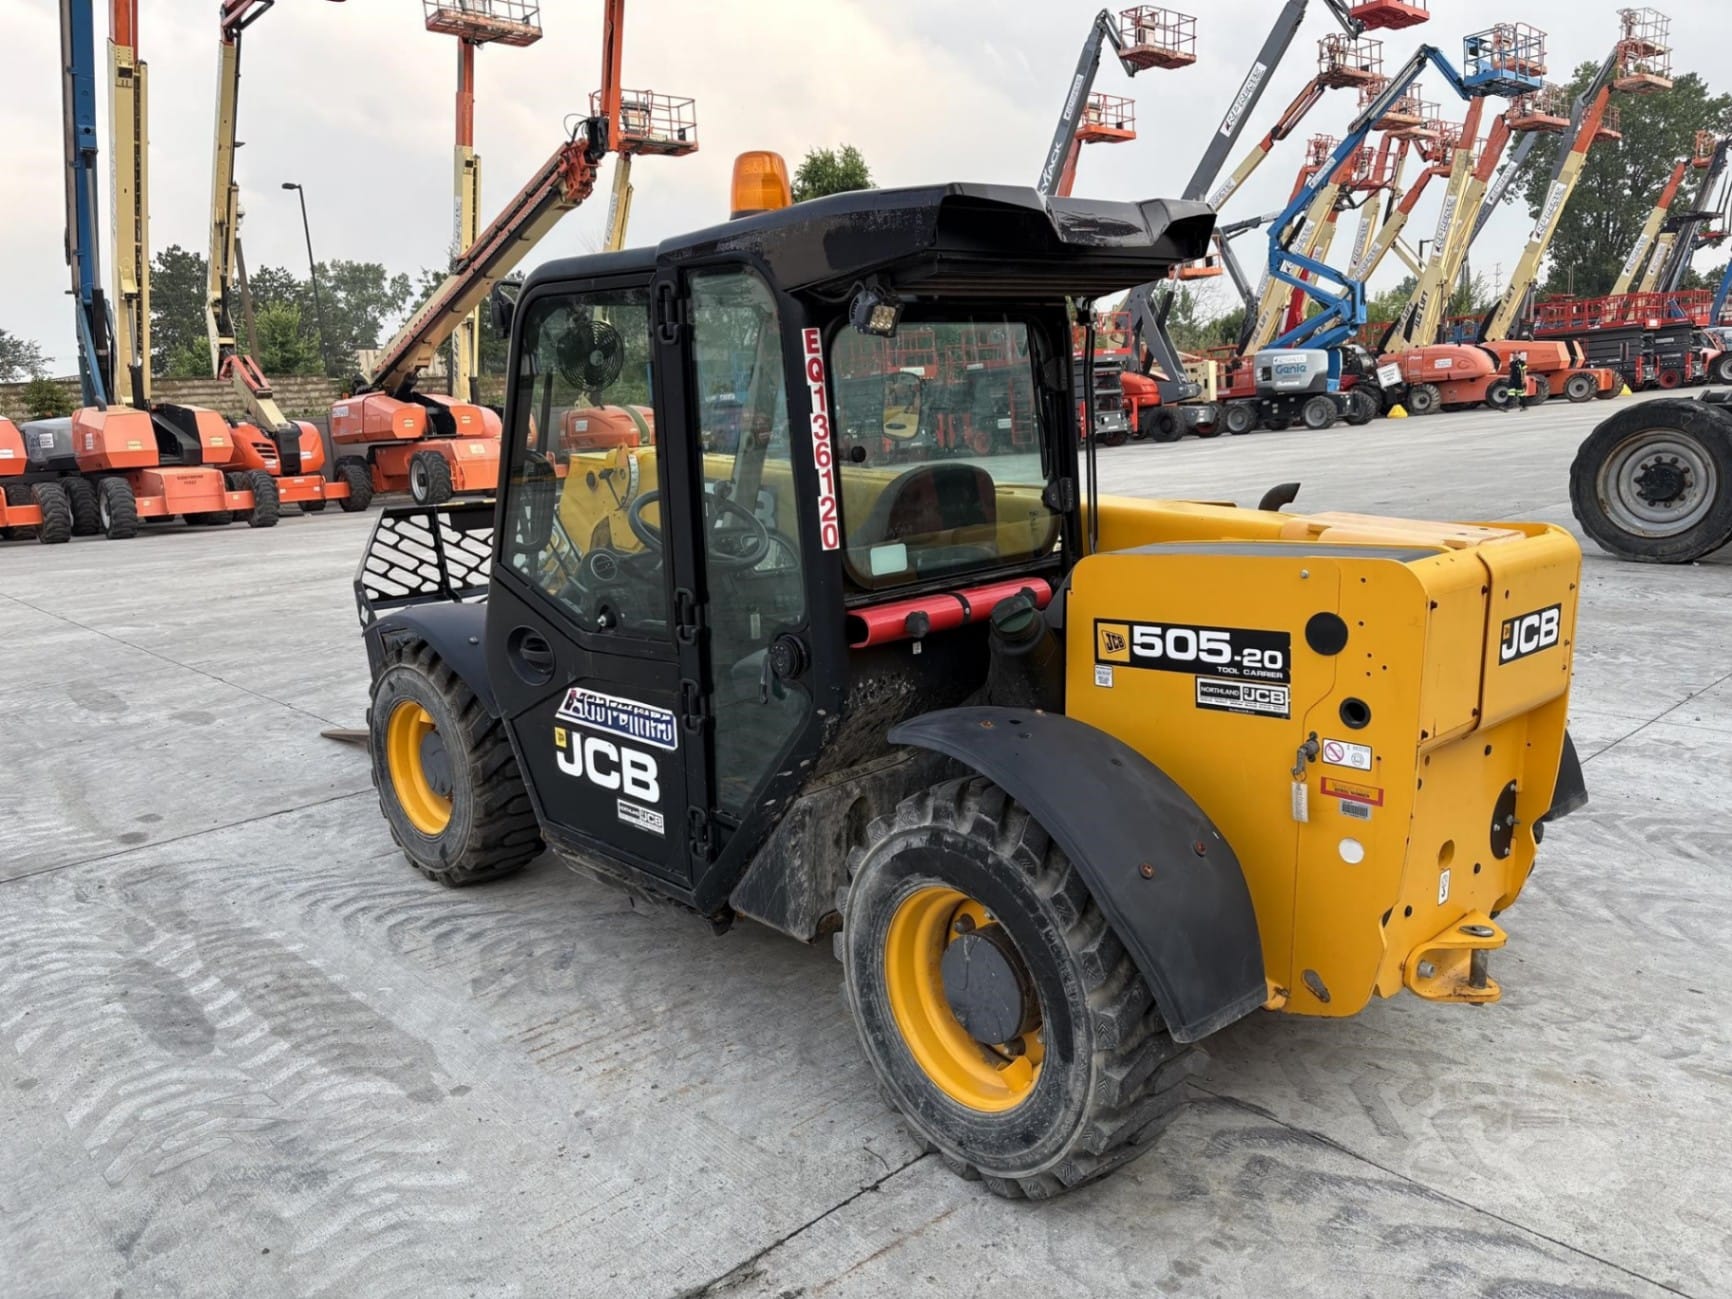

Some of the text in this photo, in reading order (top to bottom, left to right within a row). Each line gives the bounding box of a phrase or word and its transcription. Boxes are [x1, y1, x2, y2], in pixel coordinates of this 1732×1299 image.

[1038, 142, 1062, 197] KYJACK
[1419, 289, 1429, 312] LIFT
[1275, 364, 1307, 375] Genie
[805, 330, 838, 549] EQ136120
[1104, 625, 1283, 670] JCB 505-20
[1501, 608, 1559, 660] JCB
[1200, 685, 1286, 705] NORTHLAND JCB
[1217, 665, 1284, 680] TOOL CARRIER
[556, 731, 661, 803] JCB
